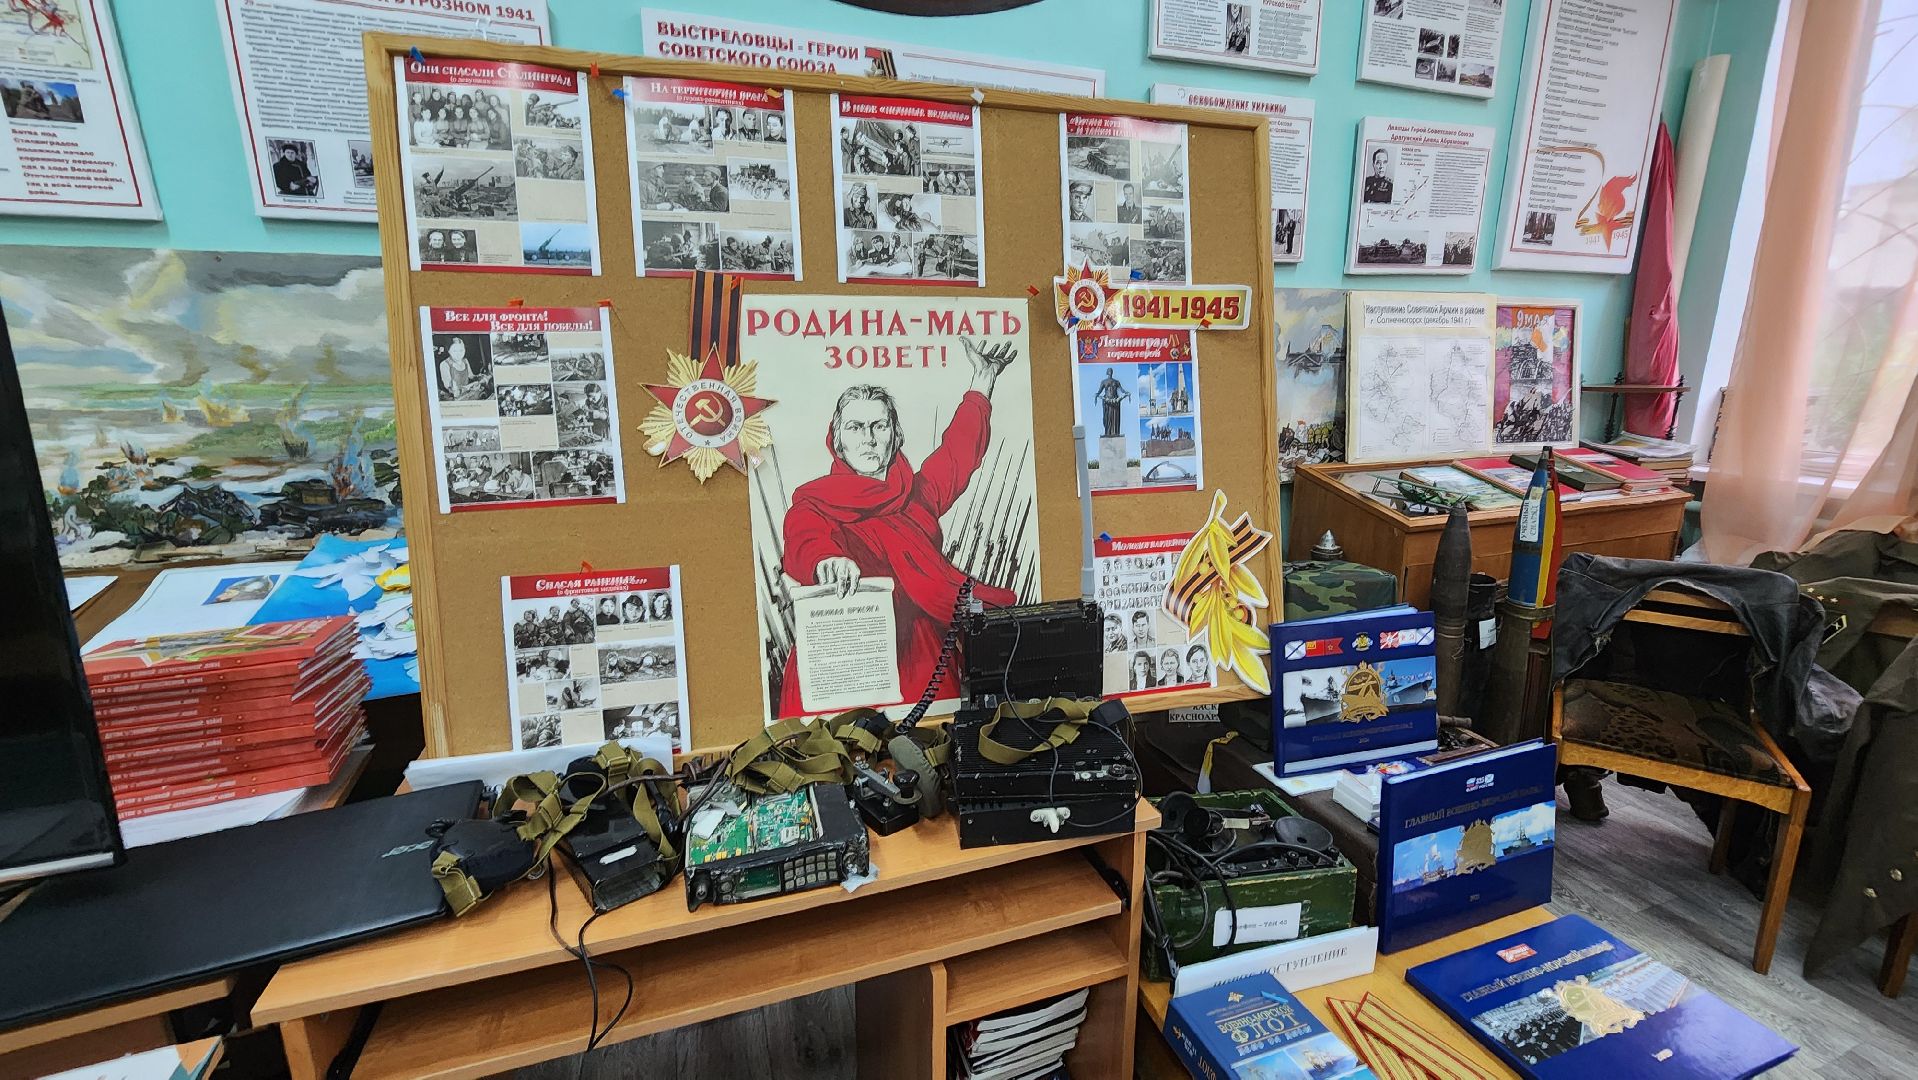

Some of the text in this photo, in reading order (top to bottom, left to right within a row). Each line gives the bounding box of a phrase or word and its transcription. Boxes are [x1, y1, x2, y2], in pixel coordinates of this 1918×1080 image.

[495, 6, 534, 21] 1941
[657, 21, 794, 51] ВЫСТРЕЛОВЦЫ
[807, 41, 859, 60] ГЕРОИ
[659, 40, 837, 74] СОВЕТСКОГО СОЮЗА
[1613, 229, 1629, 240] 1945
[1122, 295, 1240, 320] 1941-1945
[1407, 304, 1438, 315] Советской
[1439, 305, 1459, 315] Армии
[746, 309, 1021, 340] РОДИНА-МАТЬ
[1377, 316, 1422, 325] Солнечногорск
[1451, 316, 1464, 324] 1941
[1098, 335, 1169, 349] Ленинград
[824, 345, 947, 369] ЗОВЕТ!
[1170, 713, 1218, 721] КРАСНОАР
[1231, 1013, 1301, 1043] ФЛОТ
